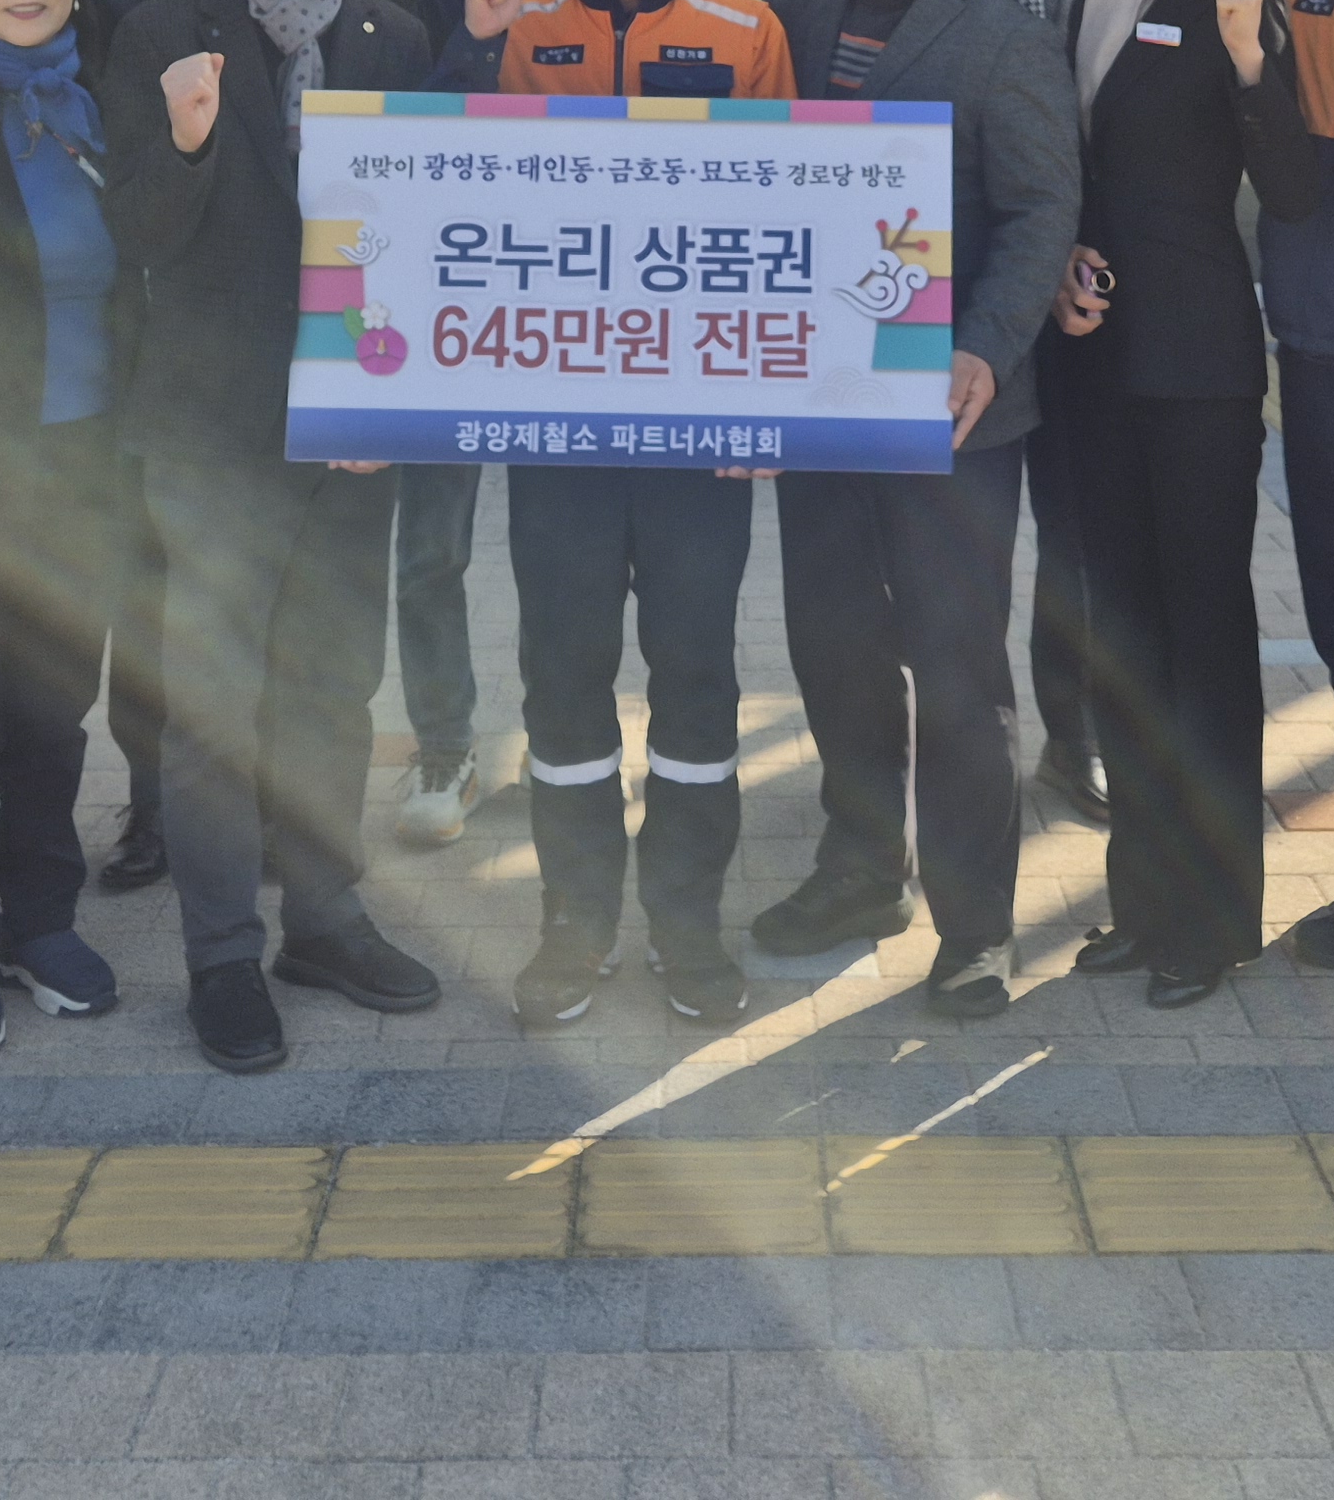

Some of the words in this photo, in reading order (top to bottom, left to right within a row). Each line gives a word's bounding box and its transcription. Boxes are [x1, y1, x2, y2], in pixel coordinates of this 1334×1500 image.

[348, 153, 415, 181] 설맞이
[785, 163, 854, 188] 경로당
[861, 164, 907, 189] 방문
[432, 221, 613, 291] 온누리
[633, 224, 815, 295] 상품권
[431, 305, 672, 378] 645만원
[693, 310, 817, 380] 전달
[453, 419, 600, 455] 광양제철소
[610, 422, 784, 459] 파트너사협회
